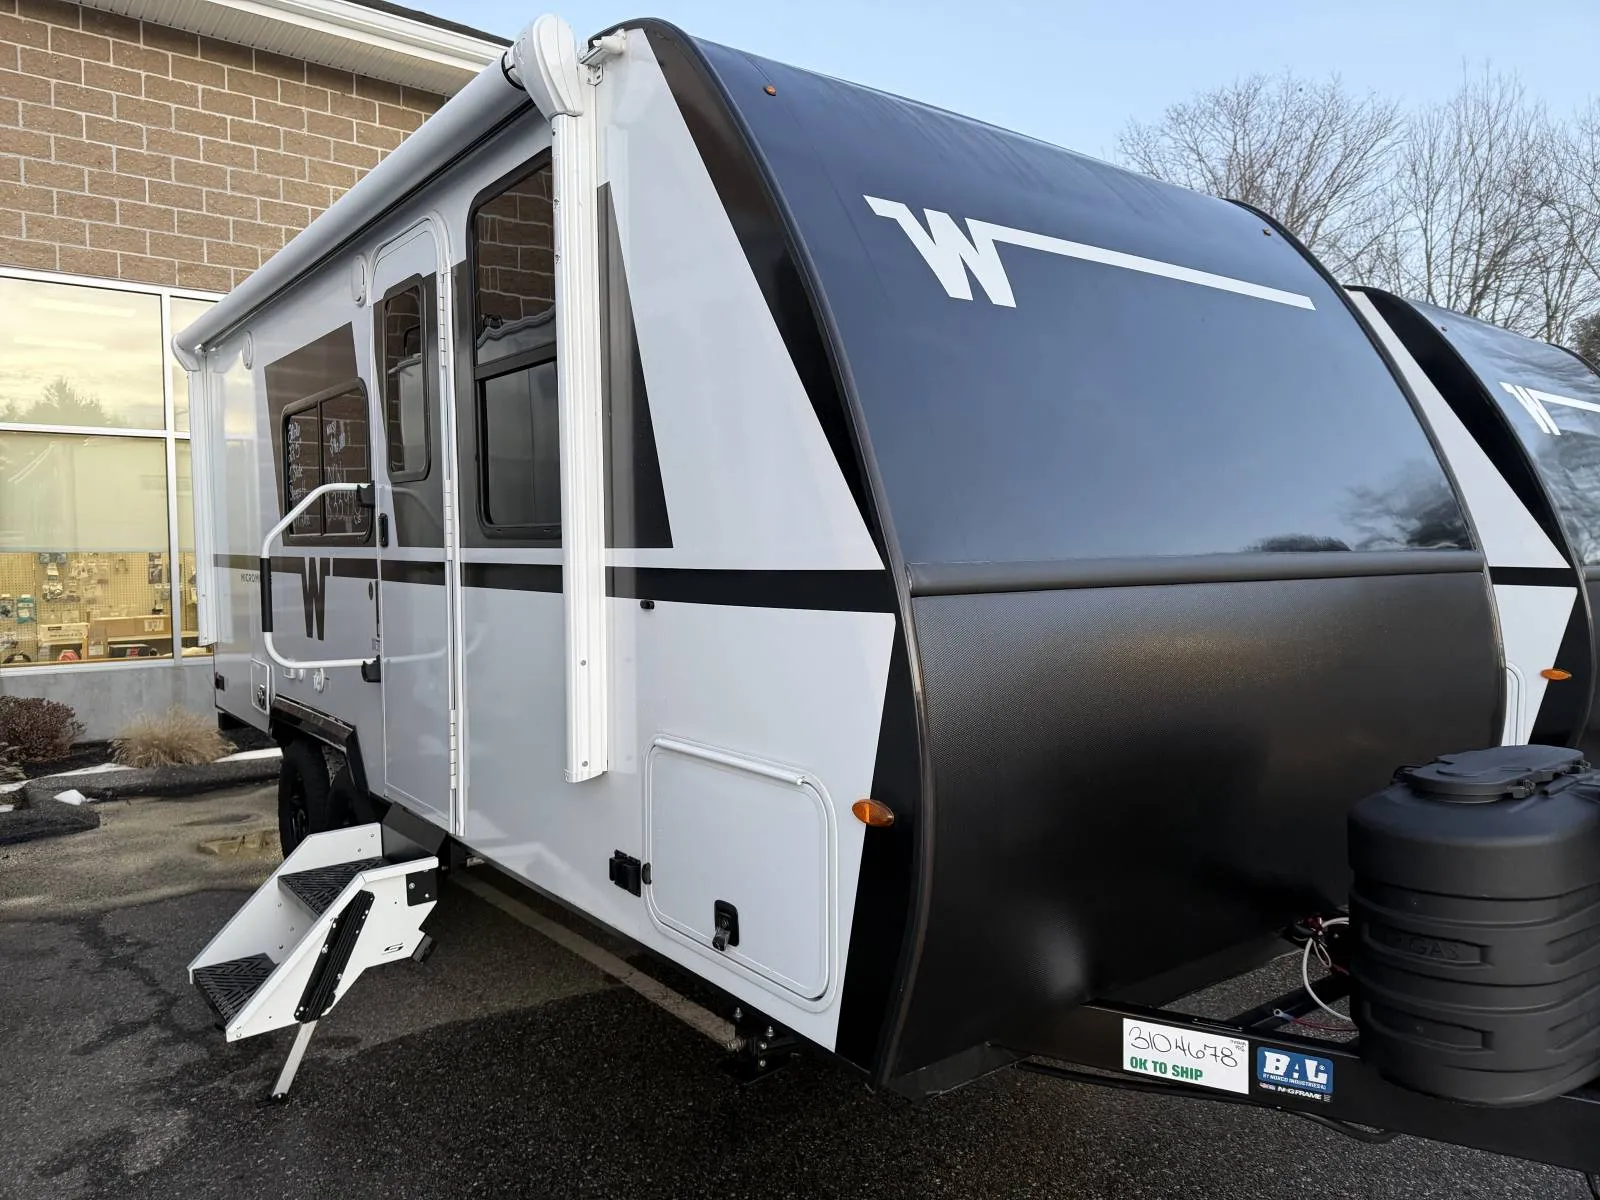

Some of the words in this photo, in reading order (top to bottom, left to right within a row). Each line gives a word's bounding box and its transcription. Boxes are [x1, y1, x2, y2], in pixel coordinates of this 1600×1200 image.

[1129, 1026, 1238, 1067] 3104678
[1129, 1056, 1148, 1071] OK
[1151, 1060, 1168, 1074] TO
[1172, 1064, 1203, 1081] SHIP
